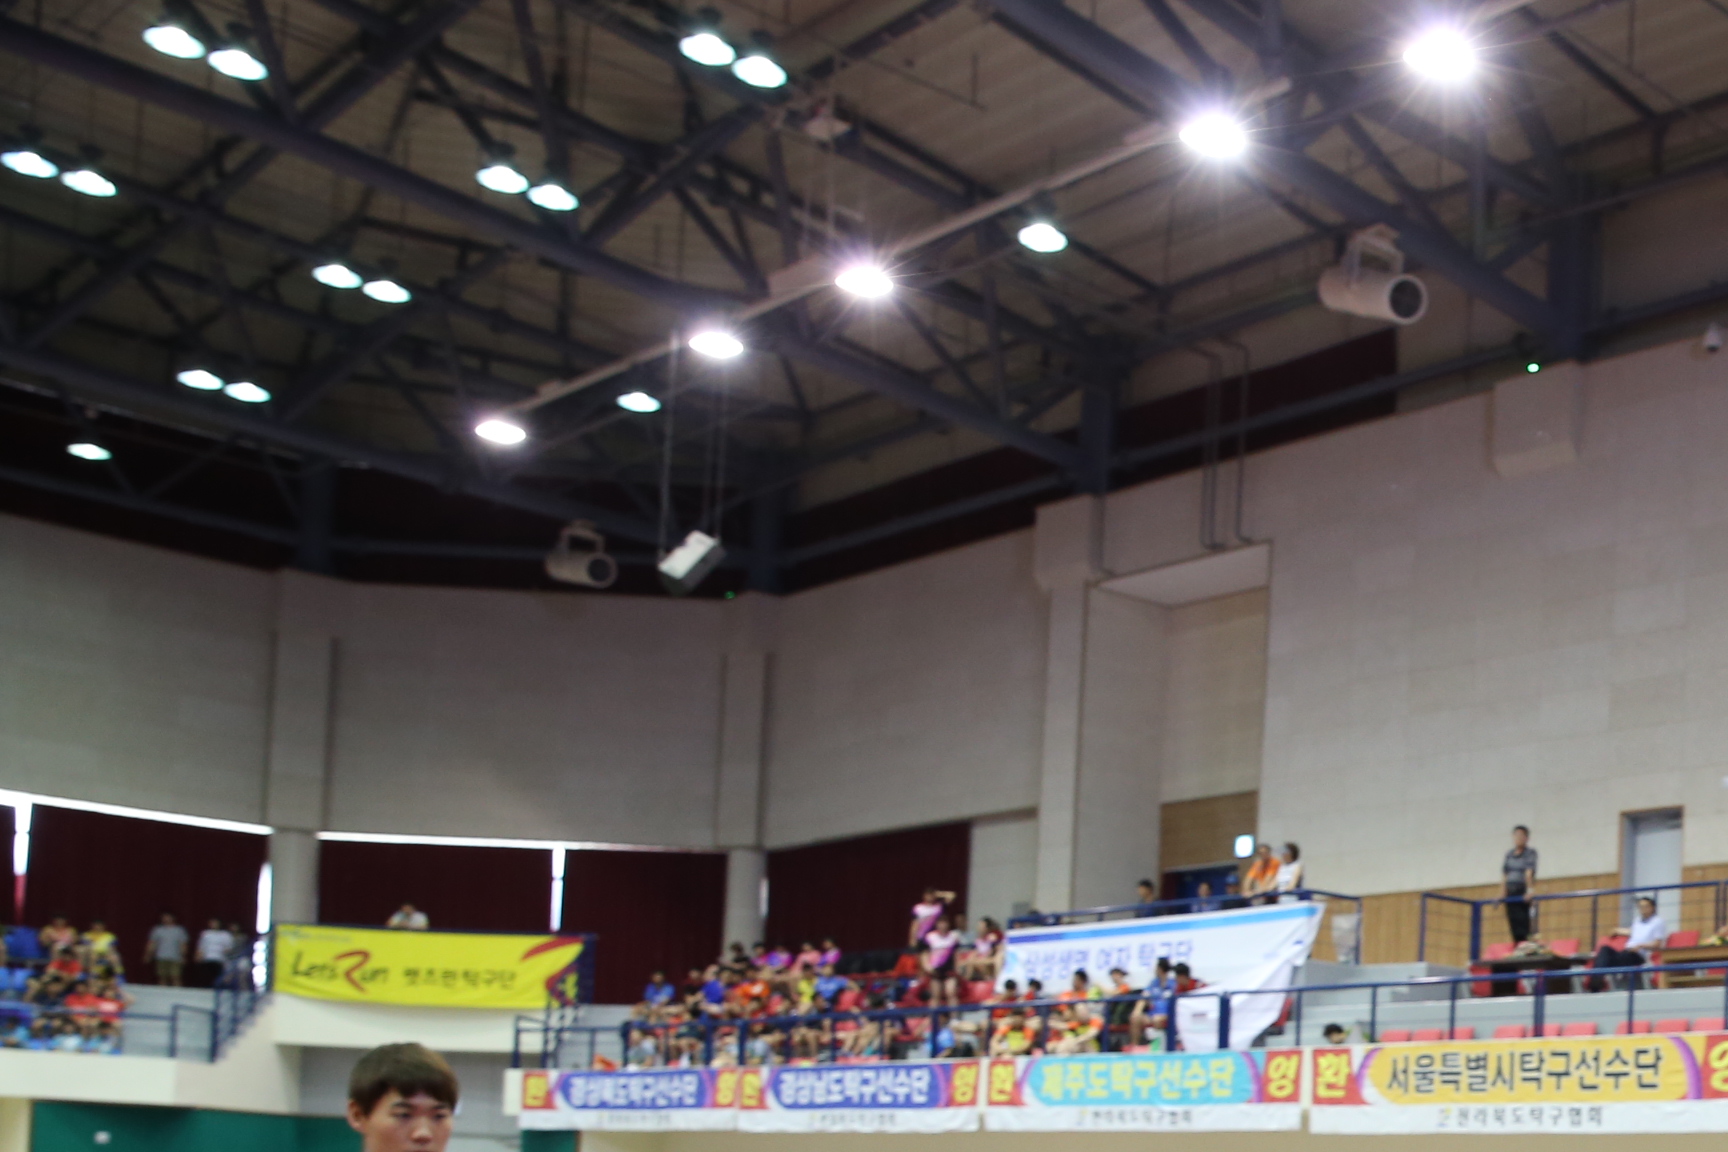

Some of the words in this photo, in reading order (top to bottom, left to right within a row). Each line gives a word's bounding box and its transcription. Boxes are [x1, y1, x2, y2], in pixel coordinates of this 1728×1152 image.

[778, 1063, 932, 1105] 경상남도탁구선수단
[952, 1062, 978, 1104] 영
[1040, 1055, 1237, 1101] 제주도탁구선수단
[1266, 1053, 1298, 1099] 영
[1315, 1053, 1351, 1099] 환
[1387, 1045, 1663, 1095] 서울특별시탁구선수단
